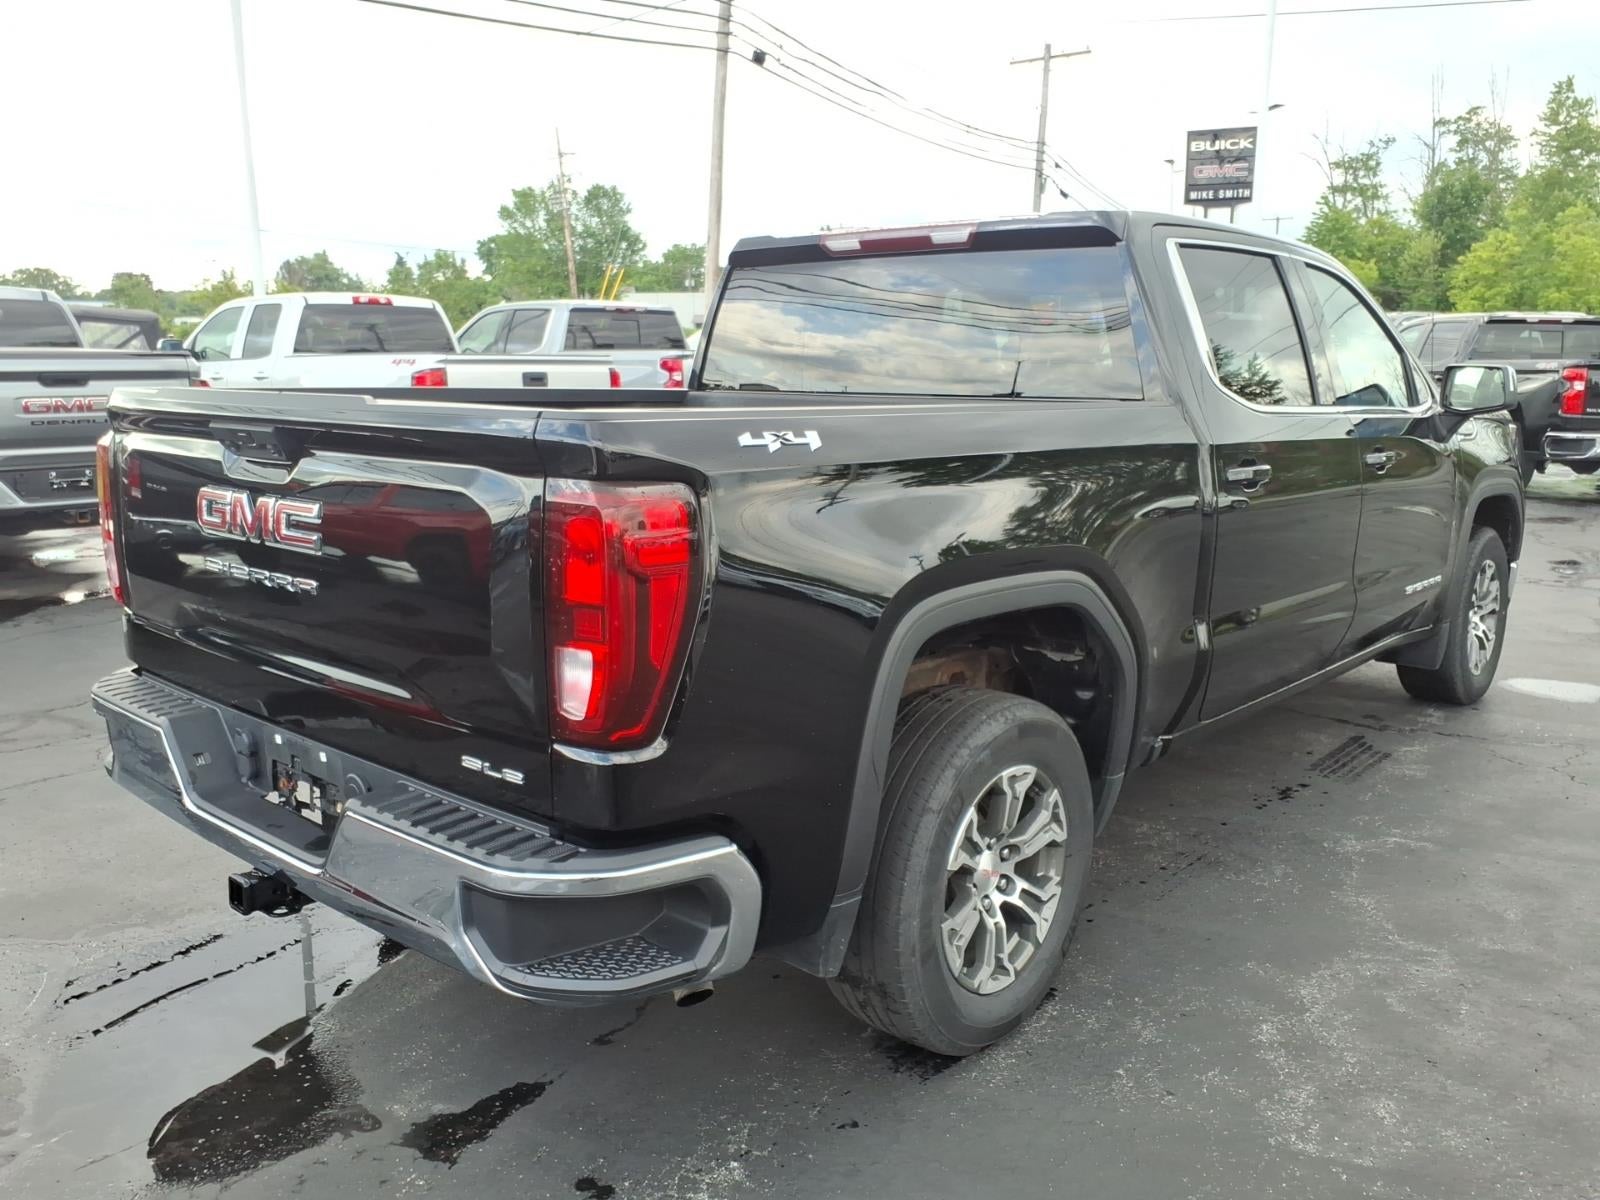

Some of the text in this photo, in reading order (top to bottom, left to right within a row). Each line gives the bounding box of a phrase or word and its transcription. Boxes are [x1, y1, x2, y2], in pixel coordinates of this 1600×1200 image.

[1190, 138, 1254, 152] BUICK
[1193, 162, 1249, 179] GMC
[1189, 188, 1251, 200] MIKE SMITH
[22, 397, 109, 415] GMC
[30, 418, 108, 426] DENALI
[196, 484, 323, 556] GMC
[204, 556, 320, 596] SIERRA
